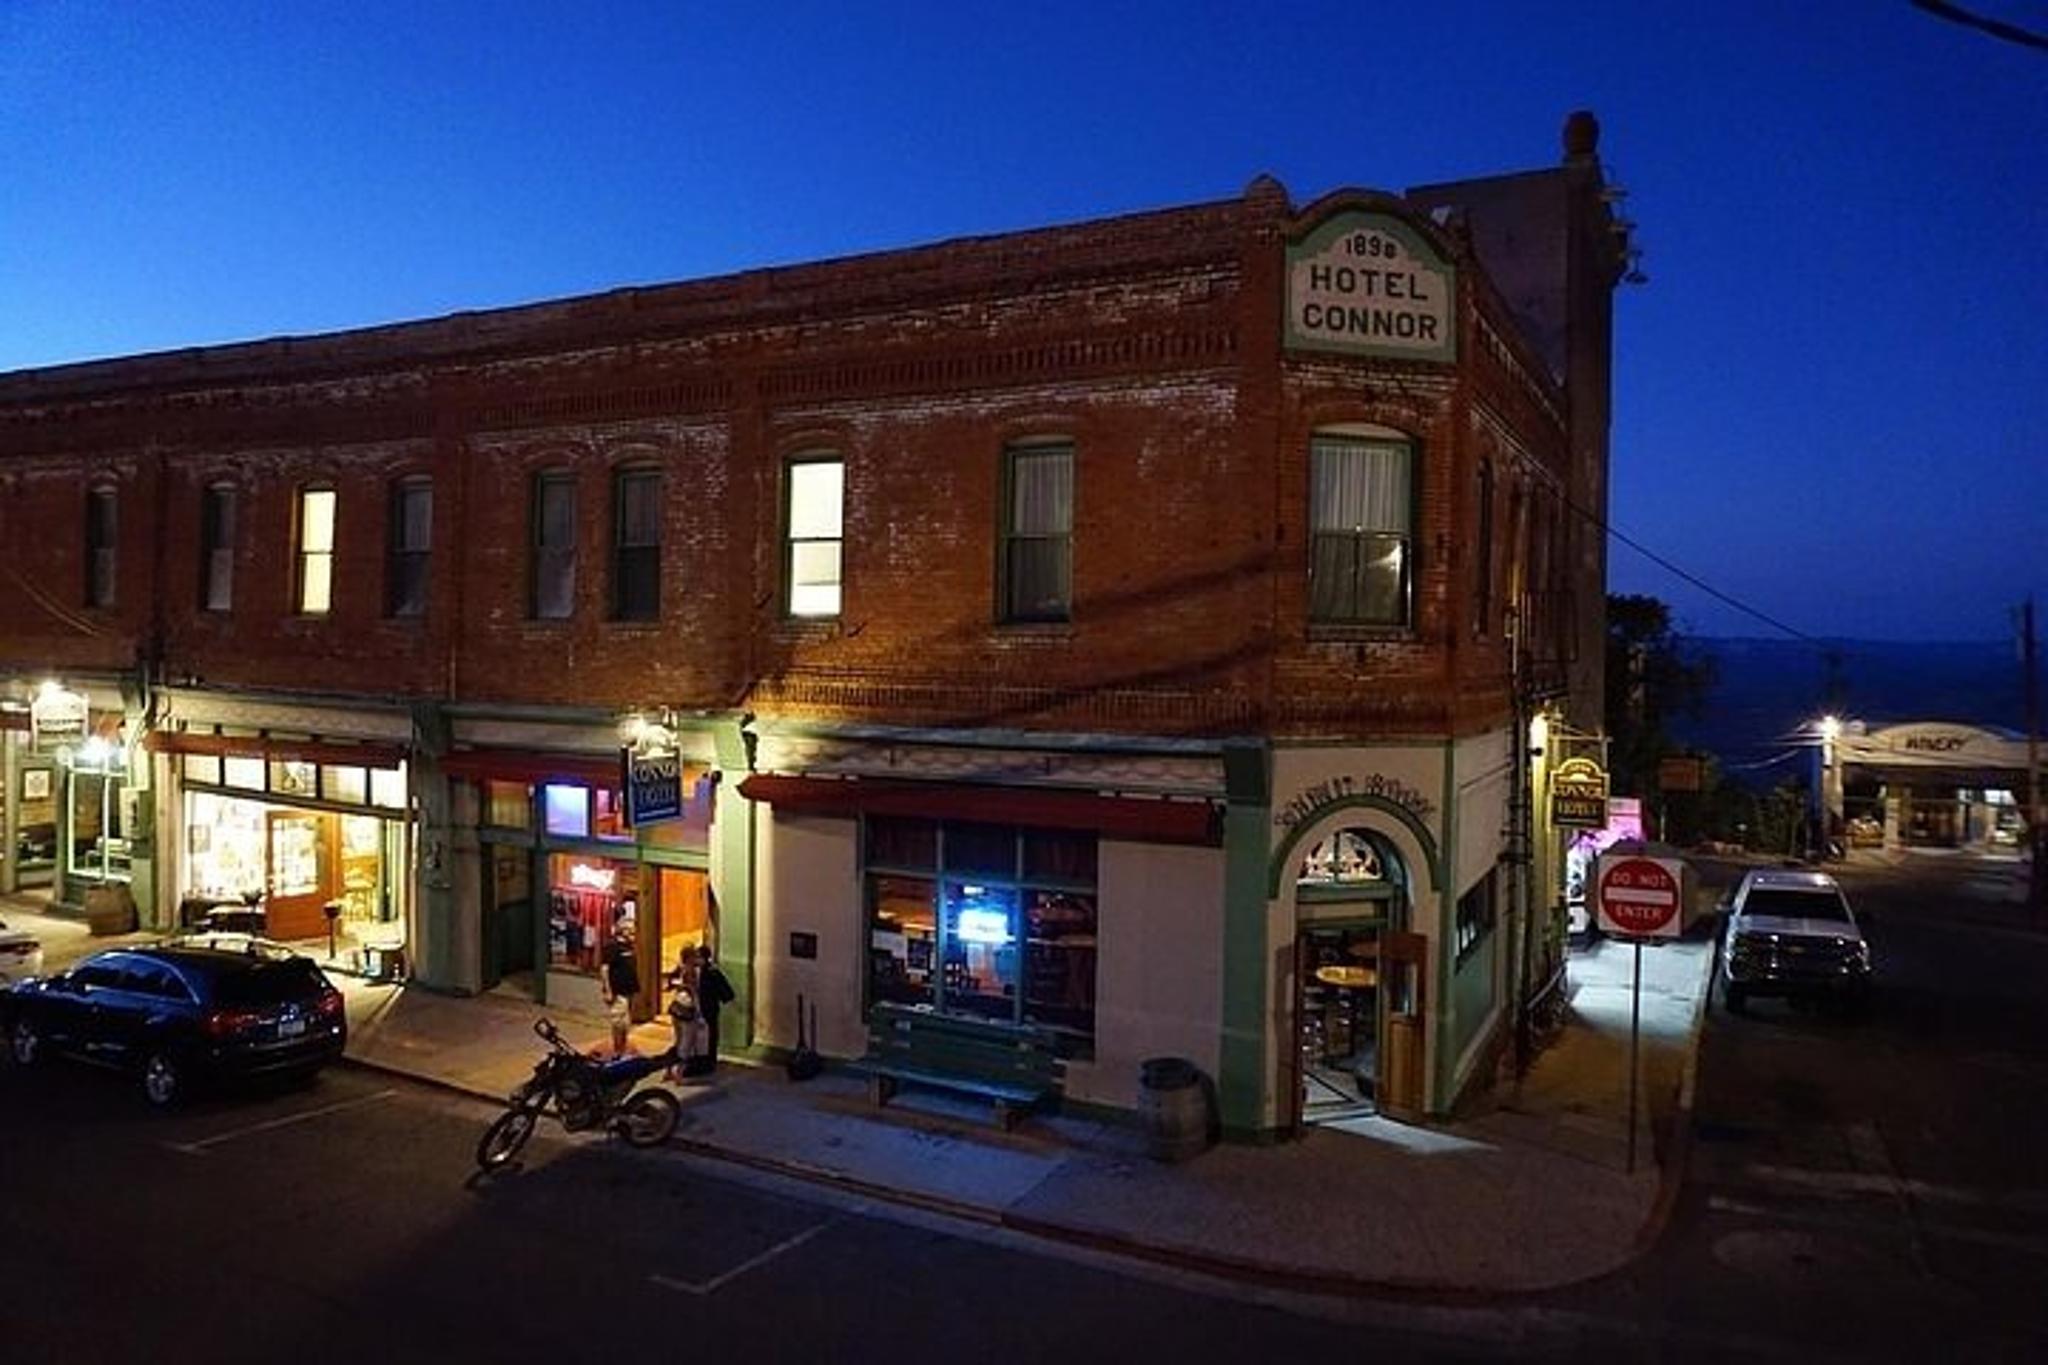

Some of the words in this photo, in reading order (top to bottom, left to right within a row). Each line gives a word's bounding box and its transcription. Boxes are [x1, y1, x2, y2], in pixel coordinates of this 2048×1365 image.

[1310, 264, 1428, 300] HOTEL
[1303, 303, 1438, 340] CONNOR
[1612, 871, 1630, 885] DO
[1640, 874, 1667, 888] NOT
[1616, 904, 1662, 919] ENTER
